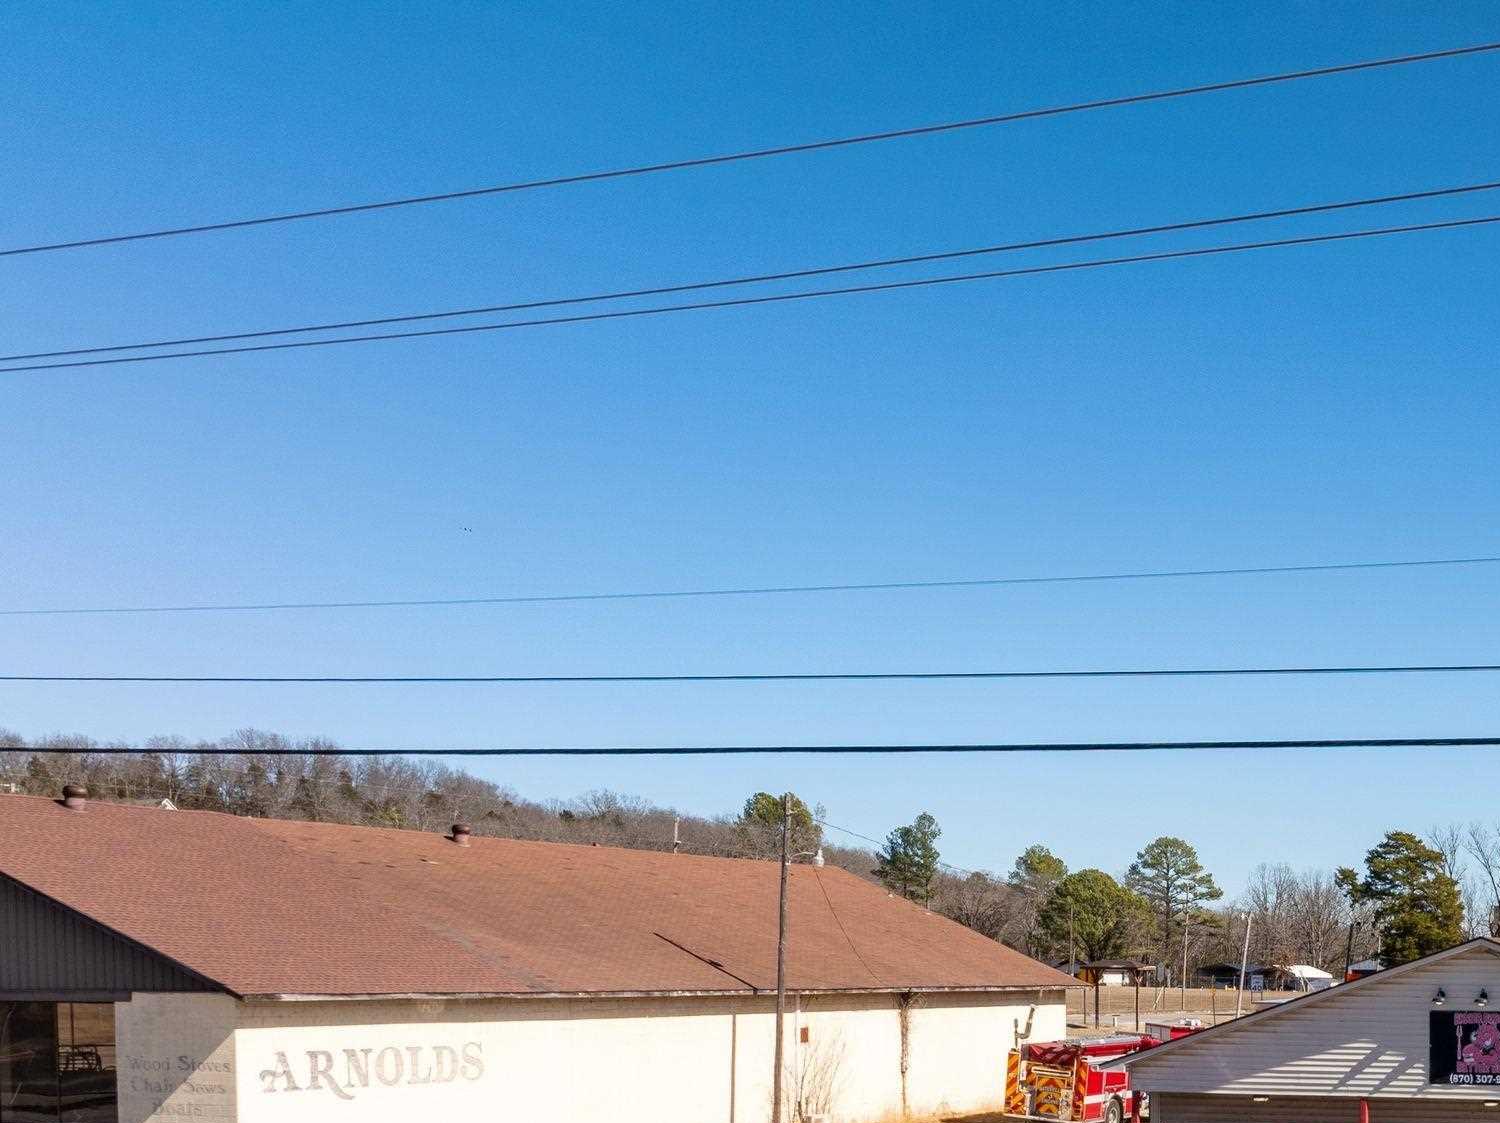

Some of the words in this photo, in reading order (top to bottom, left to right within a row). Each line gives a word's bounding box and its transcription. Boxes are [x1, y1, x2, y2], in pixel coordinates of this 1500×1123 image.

[177, 1055, 231, 1072] Stoves
[259, 1041, 484, 1100] ARNOLDS
[1450, 1073, 1473, 1084] (870)
